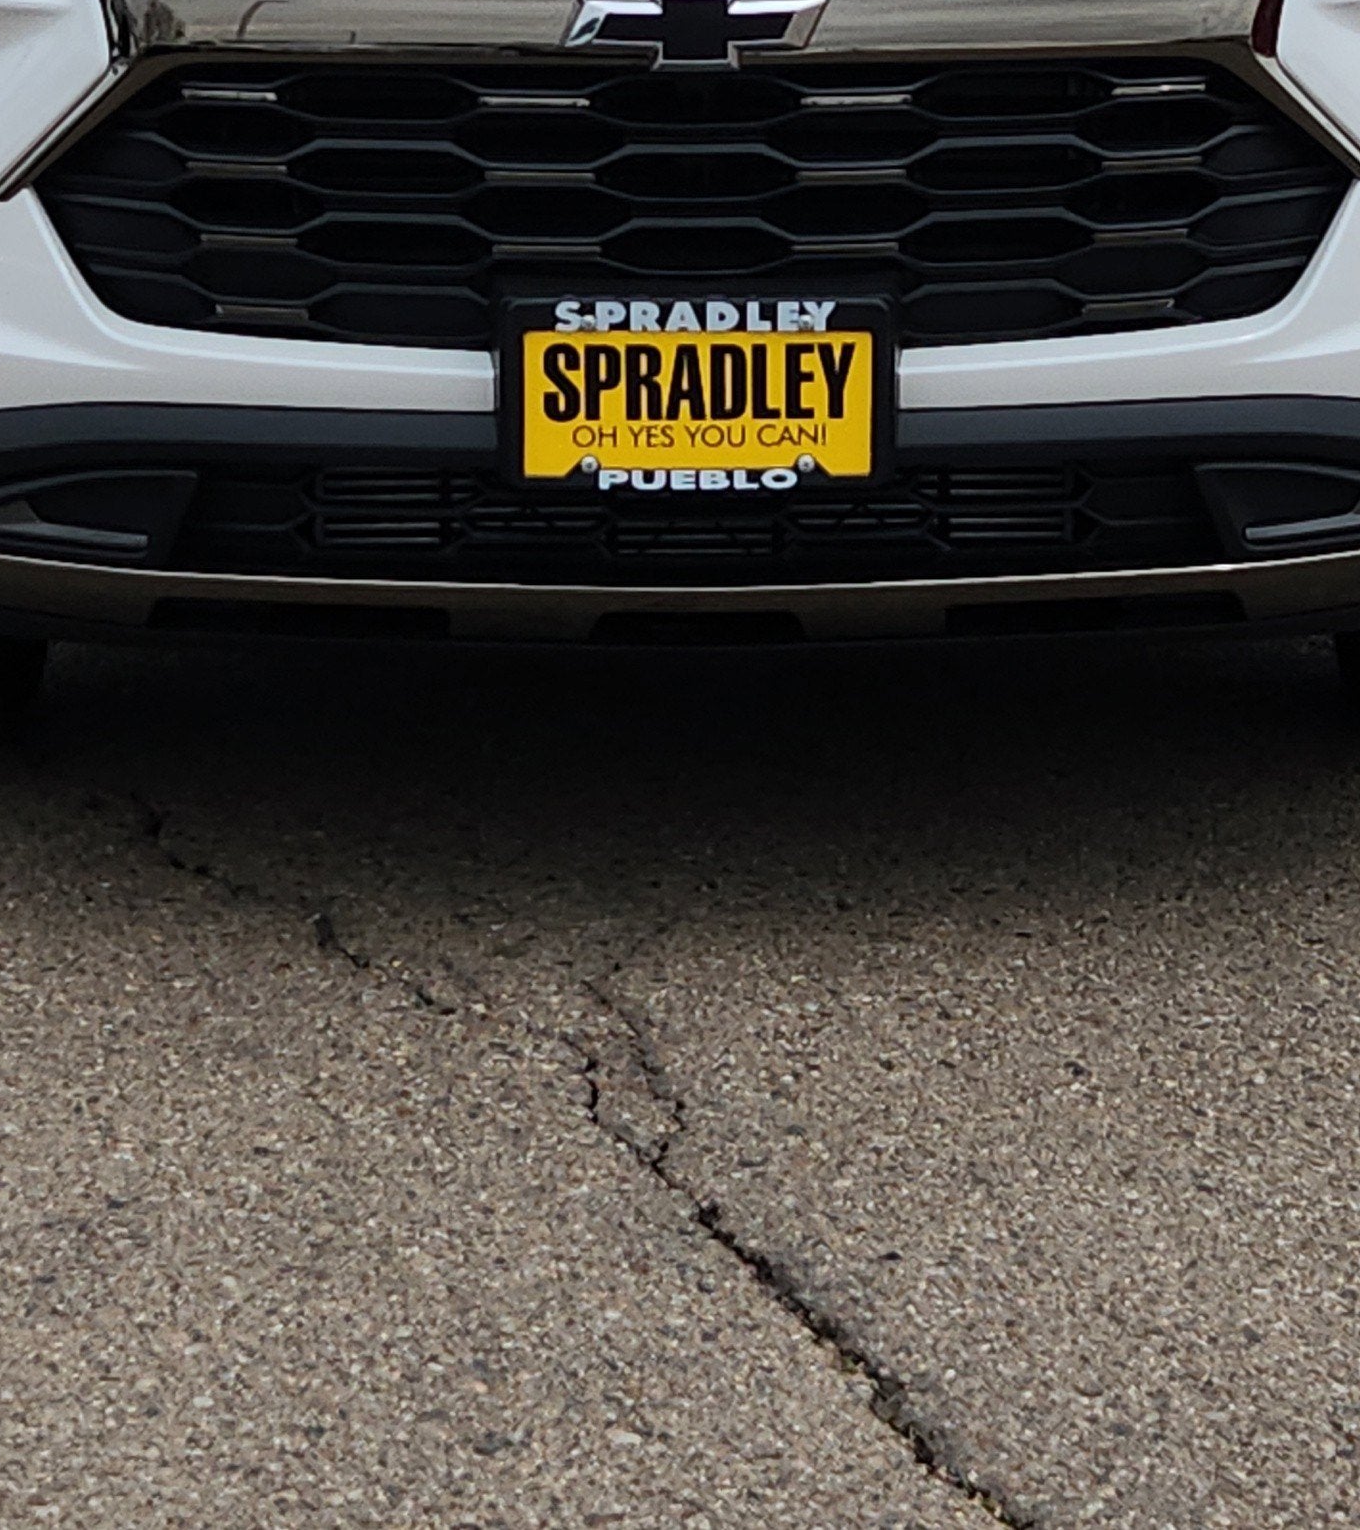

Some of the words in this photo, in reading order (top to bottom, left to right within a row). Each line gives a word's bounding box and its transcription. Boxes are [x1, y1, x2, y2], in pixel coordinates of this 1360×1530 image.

[554, 300, 836, 332] SPRADLEY
[542, 342, 857, 422] SPRADLEY
[571, 425, 618, 448] OH
[628, 425, 675, 448] YES
[685, 424, 746, 448] YOU
[757, 423, 827, 447] CAN!
[597, 468, 798, 490] PUEBLO
